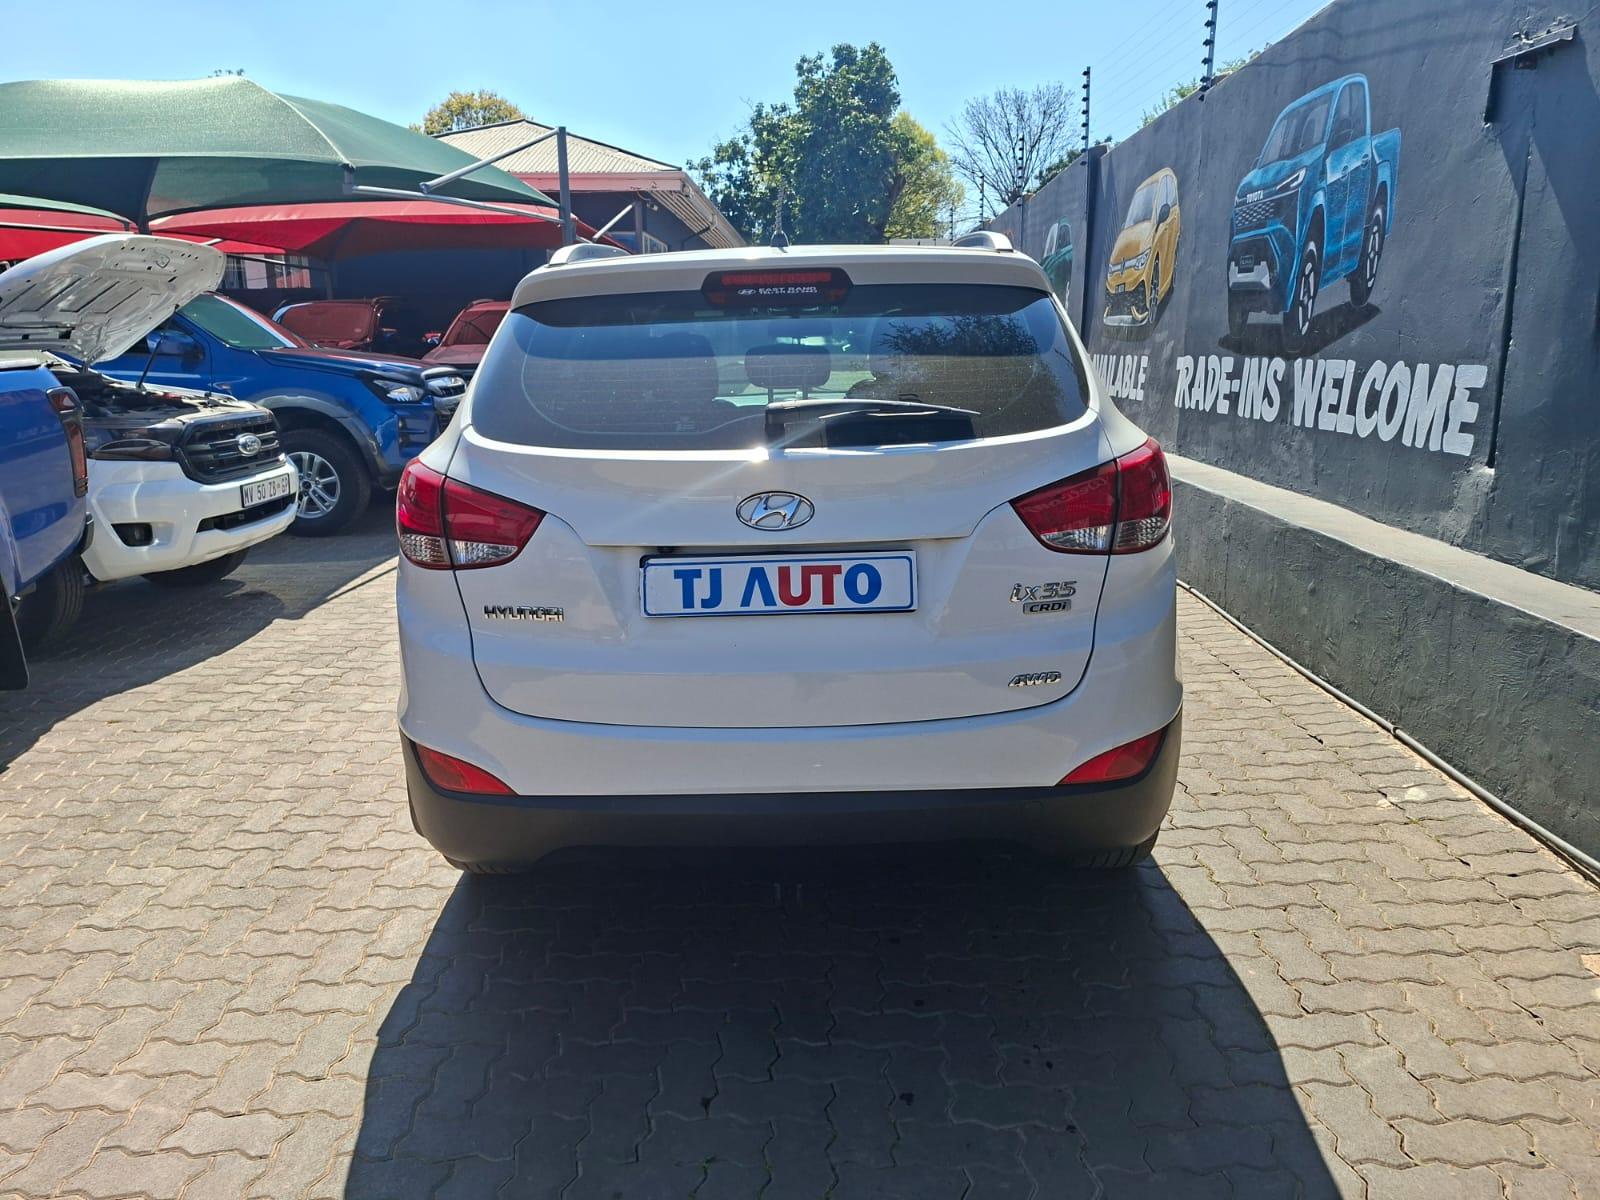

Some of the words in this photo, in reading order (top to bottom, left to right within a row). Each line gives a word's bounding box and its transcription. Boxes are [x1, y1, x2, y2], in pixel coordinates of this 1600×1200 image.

[1174, 354, 1286, 422] TRADE-INS
[1293, 357, 1488, 456] WELCOME
[673, 568, 722, 609] TJ
[739, 563, 882, 607] AUTO
[1010, 581, 1077, 602] ix35
[484, 605, 564, 622] HYUNDAI
[1029, 601, 1067, 613] CRDi
